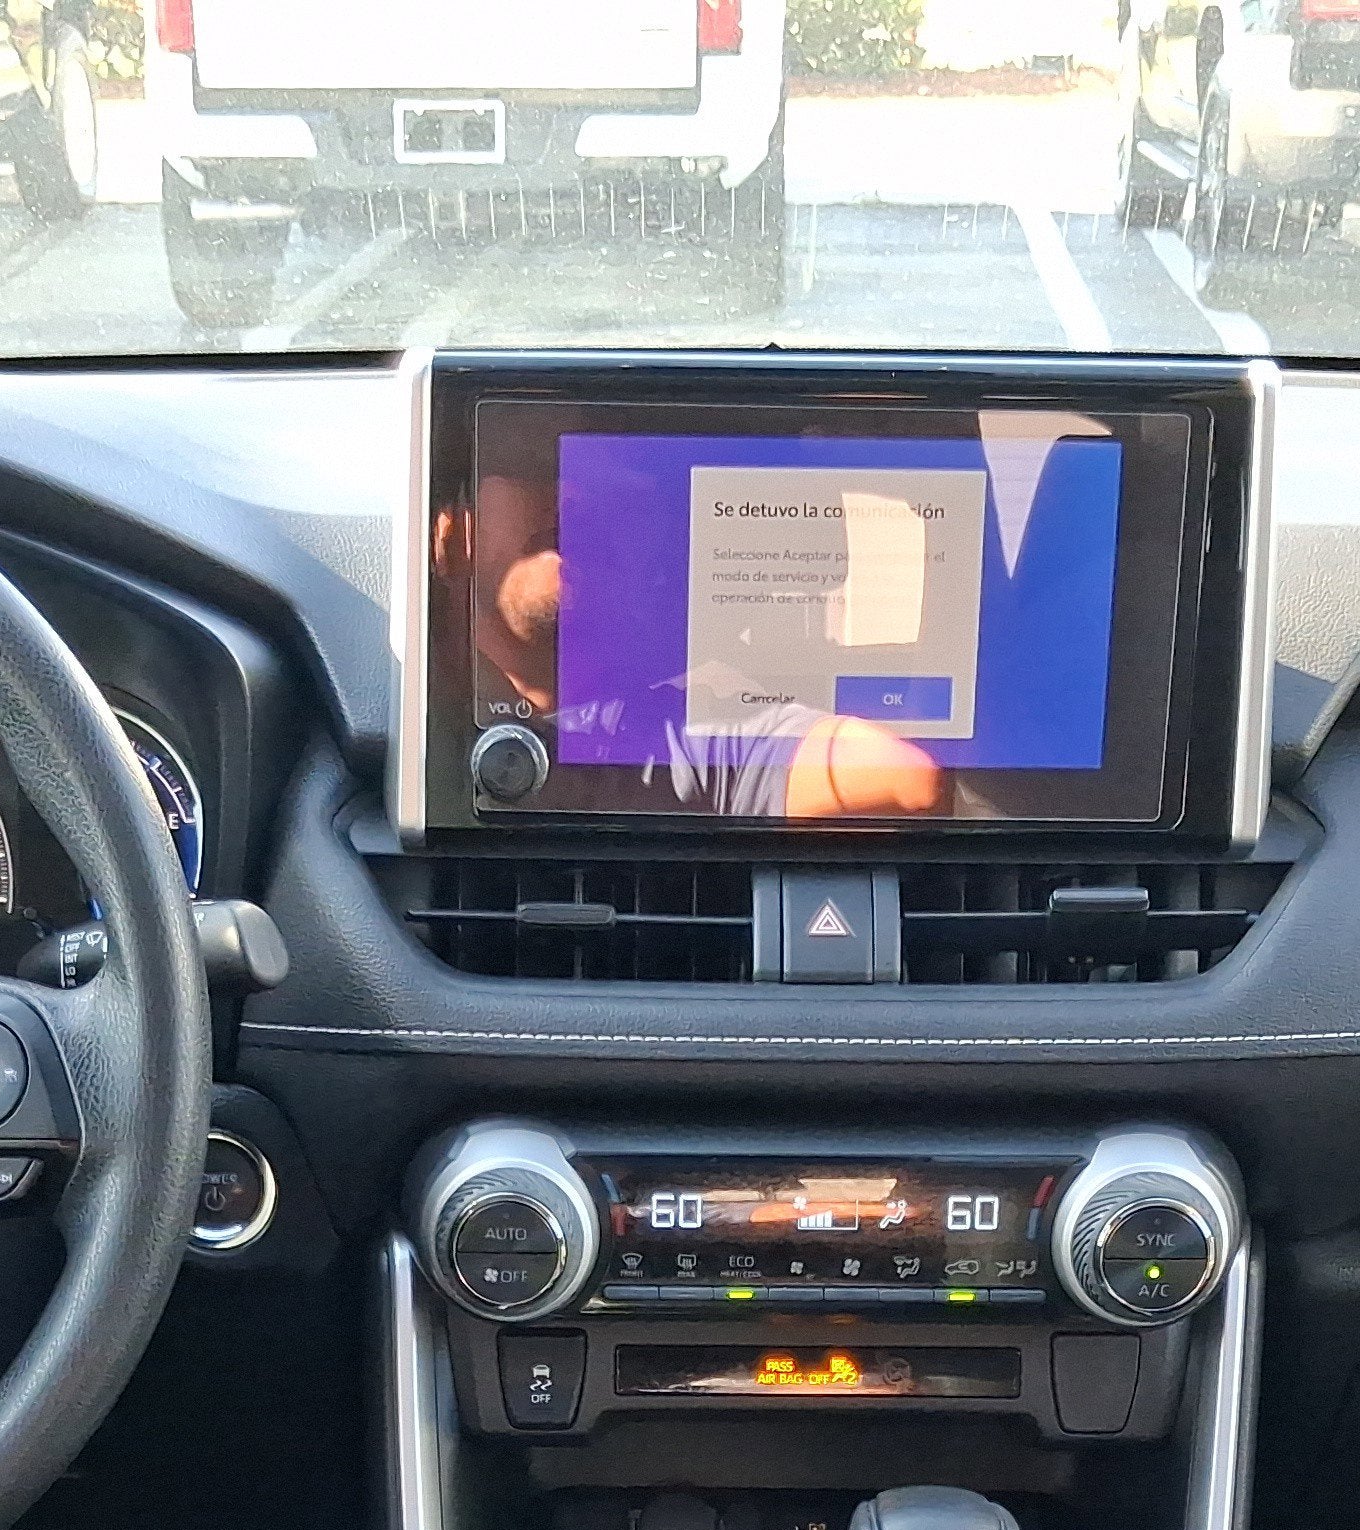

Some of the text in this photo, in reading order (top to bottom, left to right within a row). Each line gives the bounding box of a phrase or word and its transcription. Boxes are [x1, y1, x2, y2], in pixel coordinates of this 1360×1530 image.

[714, 501, 734, 518] Se
[739, 501, 799, 518] detuvo
[803, 502, 818, 518] la
[782, 549, 831, 564] Aceptar
[712, 571, 750, 582] modo
[753, 571, 769, 582] de
[772, 571, 820, 583] servicio
[741, 693, 796, 704] Cancelar
[883, 694, 904, 706] OK
[168, 813, 180, 830] E
[650, 1193, 702, 1229] 60
[946, 1195, 999, 1230] 60
[484, 1227, 527, 1241] AUTO
[1136, 1233, 1177, 1247] SYNC
[728, 1255, 755, 1268] ECO
[500, 1270, 528, 1283] OFF
[1138, 1283, 1170, 1298] A/C
[766, 1359, 794, 1372] PASS
[757, 1373, 777, 1384] AIR
[779, 1373, 803, 1384] BAG
[808, 1373, 830, 1385] OFF
[531, 1394, 551, 1403] OFF
